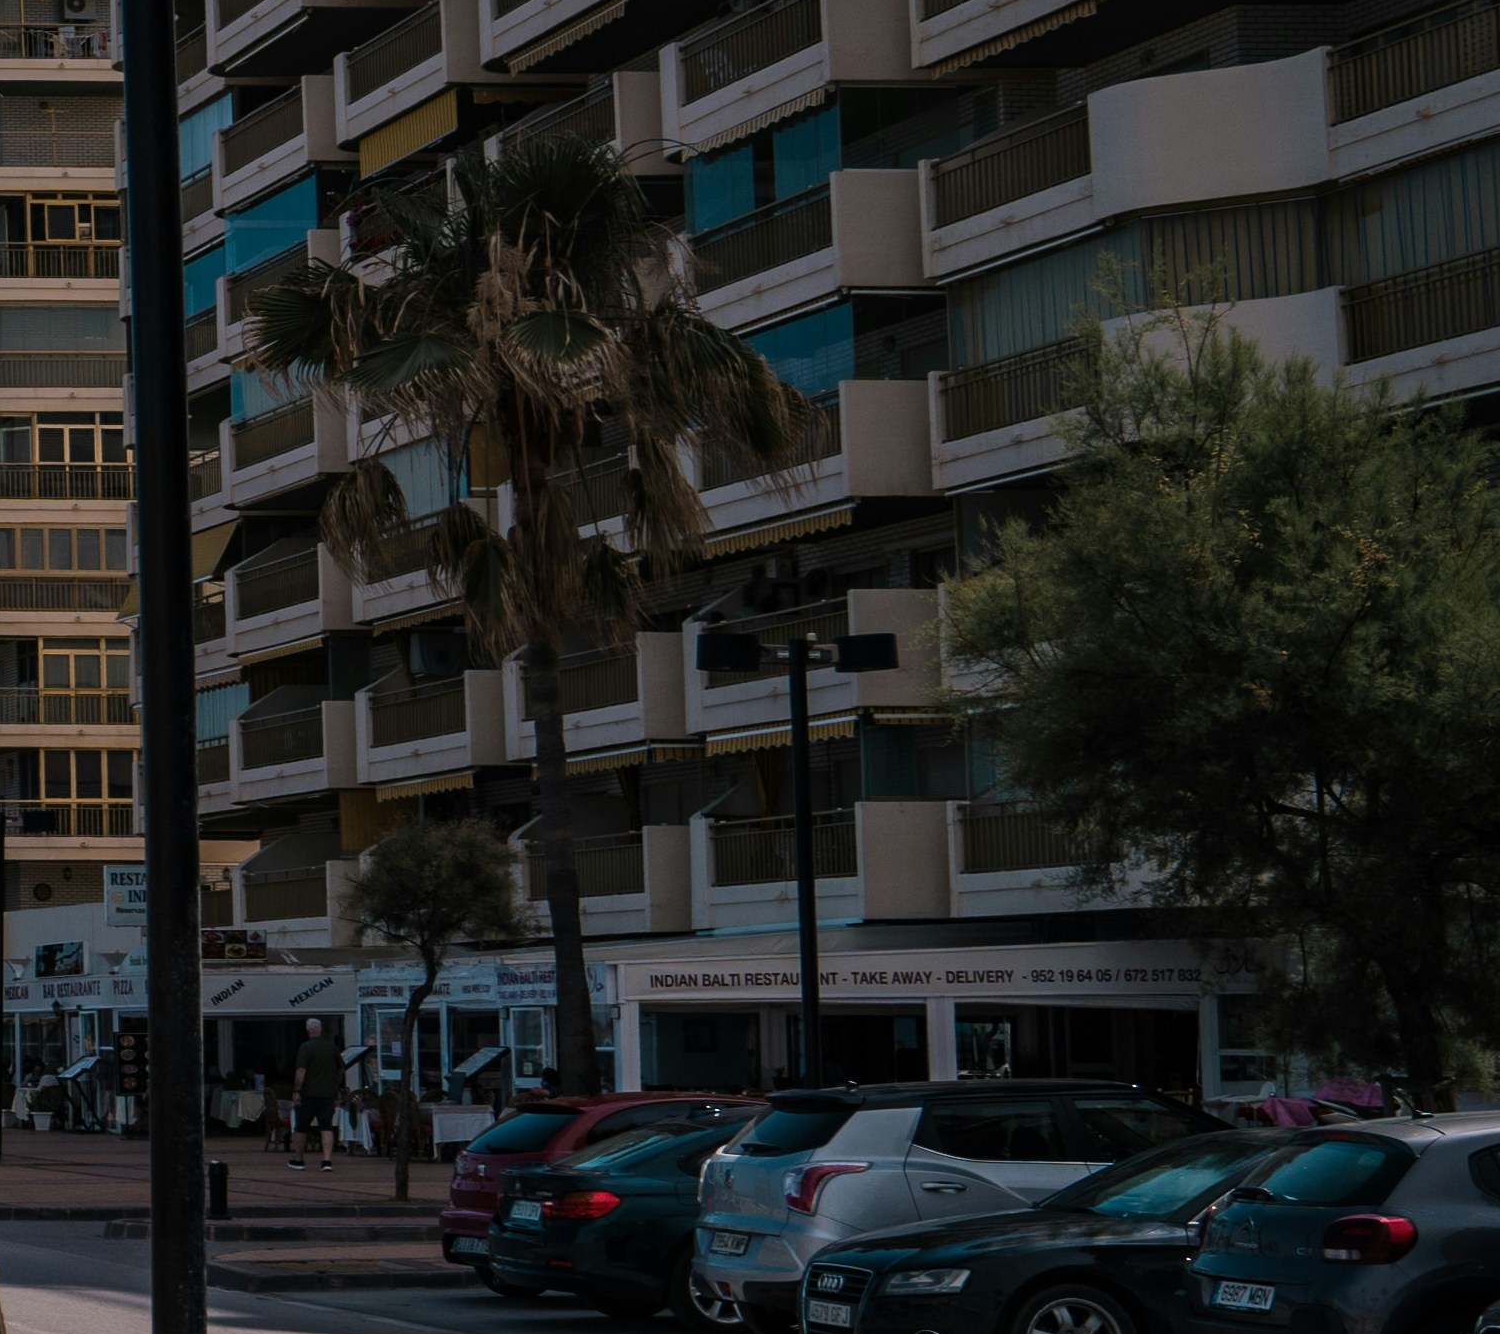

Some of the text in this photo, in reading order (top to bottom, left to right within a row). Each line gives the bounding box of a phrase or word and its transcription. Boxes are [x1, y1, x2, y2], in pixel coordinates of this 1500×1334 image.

[113, 979, 134, 995] PIZZA
[650, 974, 698, 989] INDIAN
[702, 973, 741, 987] BALTI
[744, 972, 838, 986] RESTAUNT
[851, 971, 888, 985] TAKE
[891, 971, 933, 985] AWAY
[946, 970, 1015, 984] DELIVERY
[1031, 969, 1055, 983] 952
[1059, 969, 1074, 983] 19
[1076, 969, 1093, 983] 64
[1096, 969, 1112, 982] 05
[1123, 968, 1148, 982] 672
[1151, 968, 1174, 982] 517
[1177, 968, 1201, 982] 832
[4, 985, 29, 1000] MEXICAN
[43, 980, 101, 999] BAR RESTAURANTE
[211, 979, 245, 1006] INDIAN
[289, 976, 335, 1007] MEXICAN
[1221, 1284, 1248, 1303] 6987
